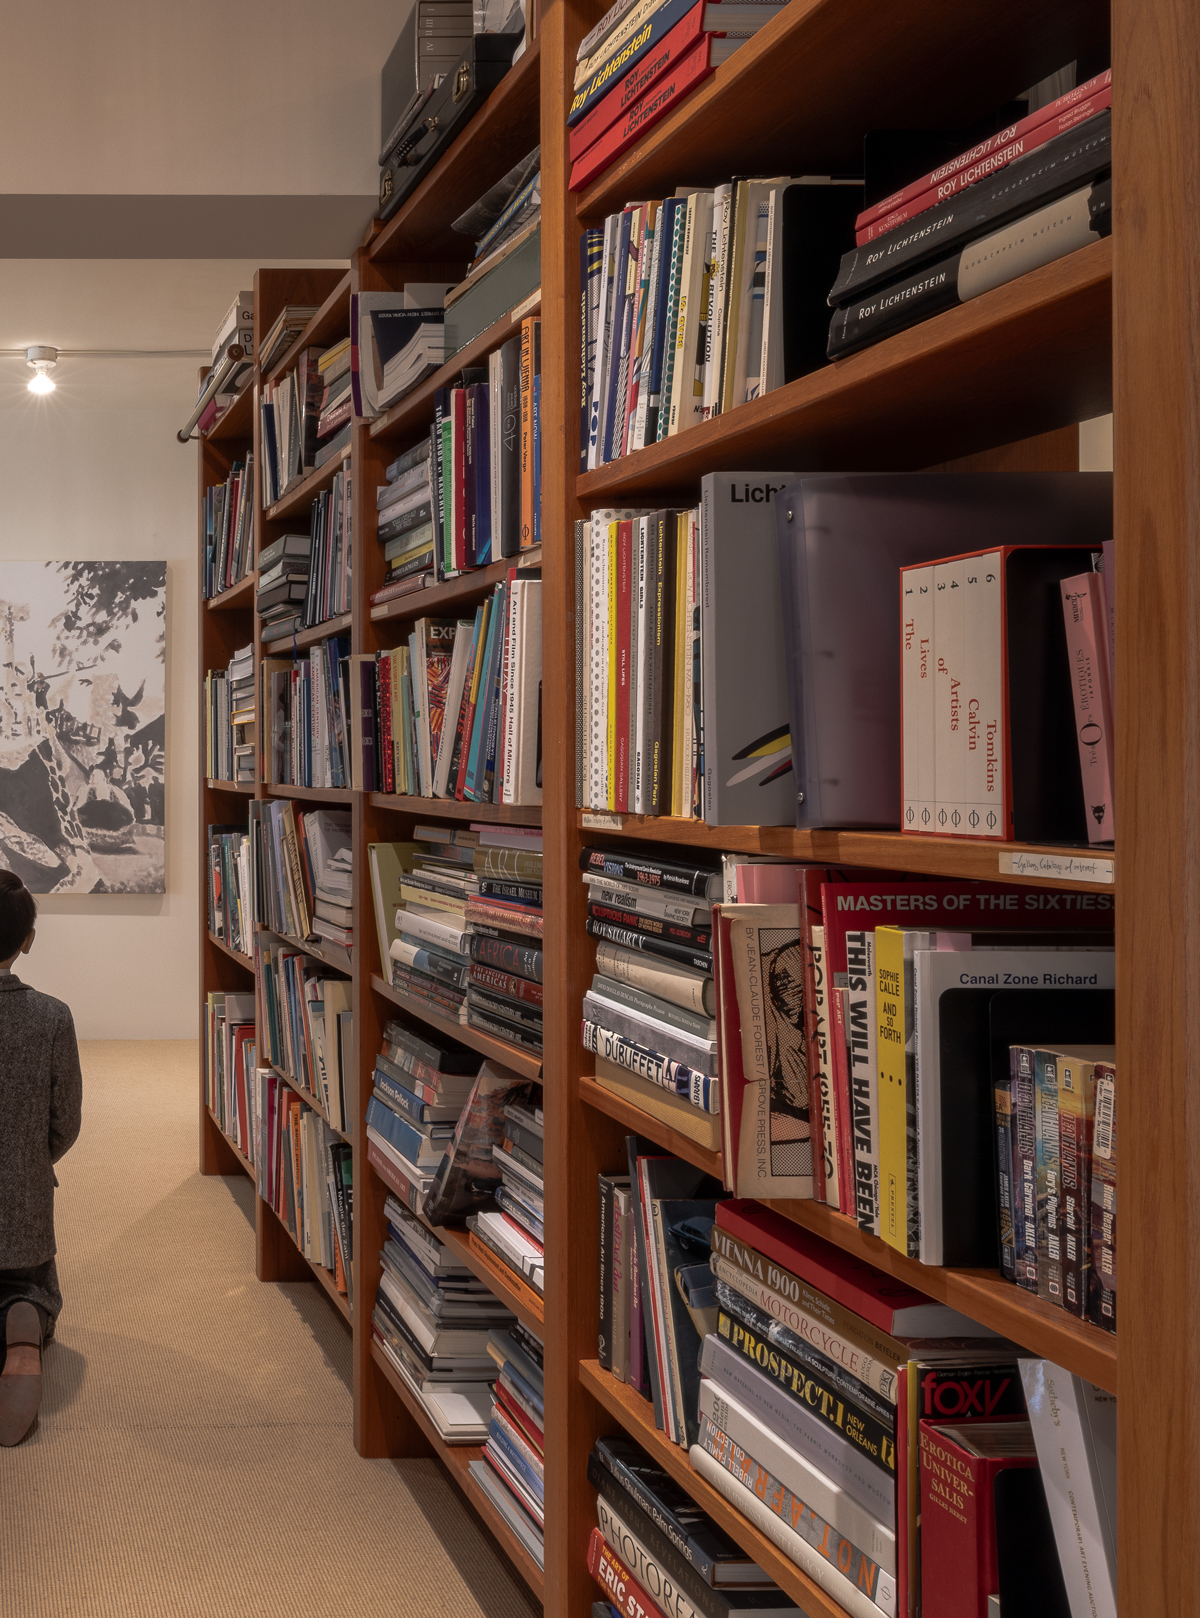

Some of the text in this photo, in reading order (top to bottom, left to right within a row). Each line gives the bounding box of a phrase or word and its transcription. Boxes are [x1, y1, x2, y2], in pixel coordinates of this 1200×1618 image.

[569, 23, 653, 115] Roy Lichtenstein
[620, 50, 671, 108] LICHTENSTEIN
[624, 69, 640, 91] ROY
[622, 82, 676, 139] LICHTENSTEIN
[628, 98, 645, 122] ROY
[930, 125, 1018, 184] ROY LICHTENSTEIN
[937, 140, 1024, 199] ROY LICHTENSTEIN
[866, 214, 955, 266] ROY LICHTENSTEIN
[964, 214, 1073, 271] GUGGENHEIM MUSEUM
[705, 229, 718, 364] THE REVOLUTION
[858, 305, 877, 321] ROY
[879, 272, 947, 311] LICHTENSTEIN
[591, 400, 600, 447] POP
[510, 637, 518, 659] Film
[905, 618, 915, 651] The
[509, 661, 517, 690] Since
[919, 637, 930, 679] Lives
[937, 656, 949, 675] of
[457, 643, 477, 735] METROPOLIS
[950, 677, 962, 732] Artists
[967, 698, 981, 752] Calvin
[505, 748, 514, 784] Mirrors
[986, 719, 997, 793] Tomkins
[492, 884, 538, 901] THE ISRAEL MUSEUM
[600, 889, 638, 910] new realism
[836, 894, 938, 911] MASTERS
[943, 894, 972, 911] OF
[976, 894, 1019, 911] THE
[591, 904, 640, 927] VOLUPTUOUS PANIC
[473, 965, 508, 981] THE ANCIENT
[478, 937, 521, 973] AFRICA
[472, 971, 508, 990] AMERICAS
[878, 968, 900, 984] SOPHIE
[879, 981, 901, 997] CALLE
[959, 973, 1098, 985] Canal Zone Richard
[882, 1001, 897, 1018] AND
[886, 1016, 894, 1028] SO
[745, 927, 767, 1181] BY JEAN-CLAUDE FOREST GROVE PRESS, INC.
[879, 1025, 902, 1045] FORTH
[604, 1034, 664, 1084] DUBUFFET
[379, 1077, 410, 1110] Jackson Pollock
[847, 931, 876, 1236] THIS WILL HAVE BEEN
[1022, 1159, 1034, 1219] Dark Carnival
[337, 1190, 345, 1219] Magie
[342, 1238, 350, 1261] Zahl
[599, 1195, 607, 1245] American
[1065, 1195, 1076, 1230] Starfall
[1025, 1220, 1036, 1248] AXLER
[1048, 1233, 1059, 1261] AXLER
[1066, 1233, 1076, 1262] AXLER
[713, 1230, 800, 1302] VIENNA 1900
[1101, 1246, 1114, 1275] AXLER
[759, 1290, 860, 1373] MOTORCYCLE
[730, 1320, 845, 1430] PROSPECT.1
[921, 1372, 1011, 1416] foxy
[846, 1412, 866, 1432] NEW
[1047, 1379, 1061, 1427] Sotheby's
[845, 1425, 879, 1457] ORLEANS
[919, 1431, 975, 1483] EROTICA
[922, 1450, 974, 1498] UNIVER-
[609, 1463, 694, 1562] Julius Shulman: Palm Springs
[931, 1479, 964, 1510] SALIS
[591, 1467, 716, 1614] DIANE ARBUS REVELATIONS
[602, 1545, 630, 1582] THE ART OF
